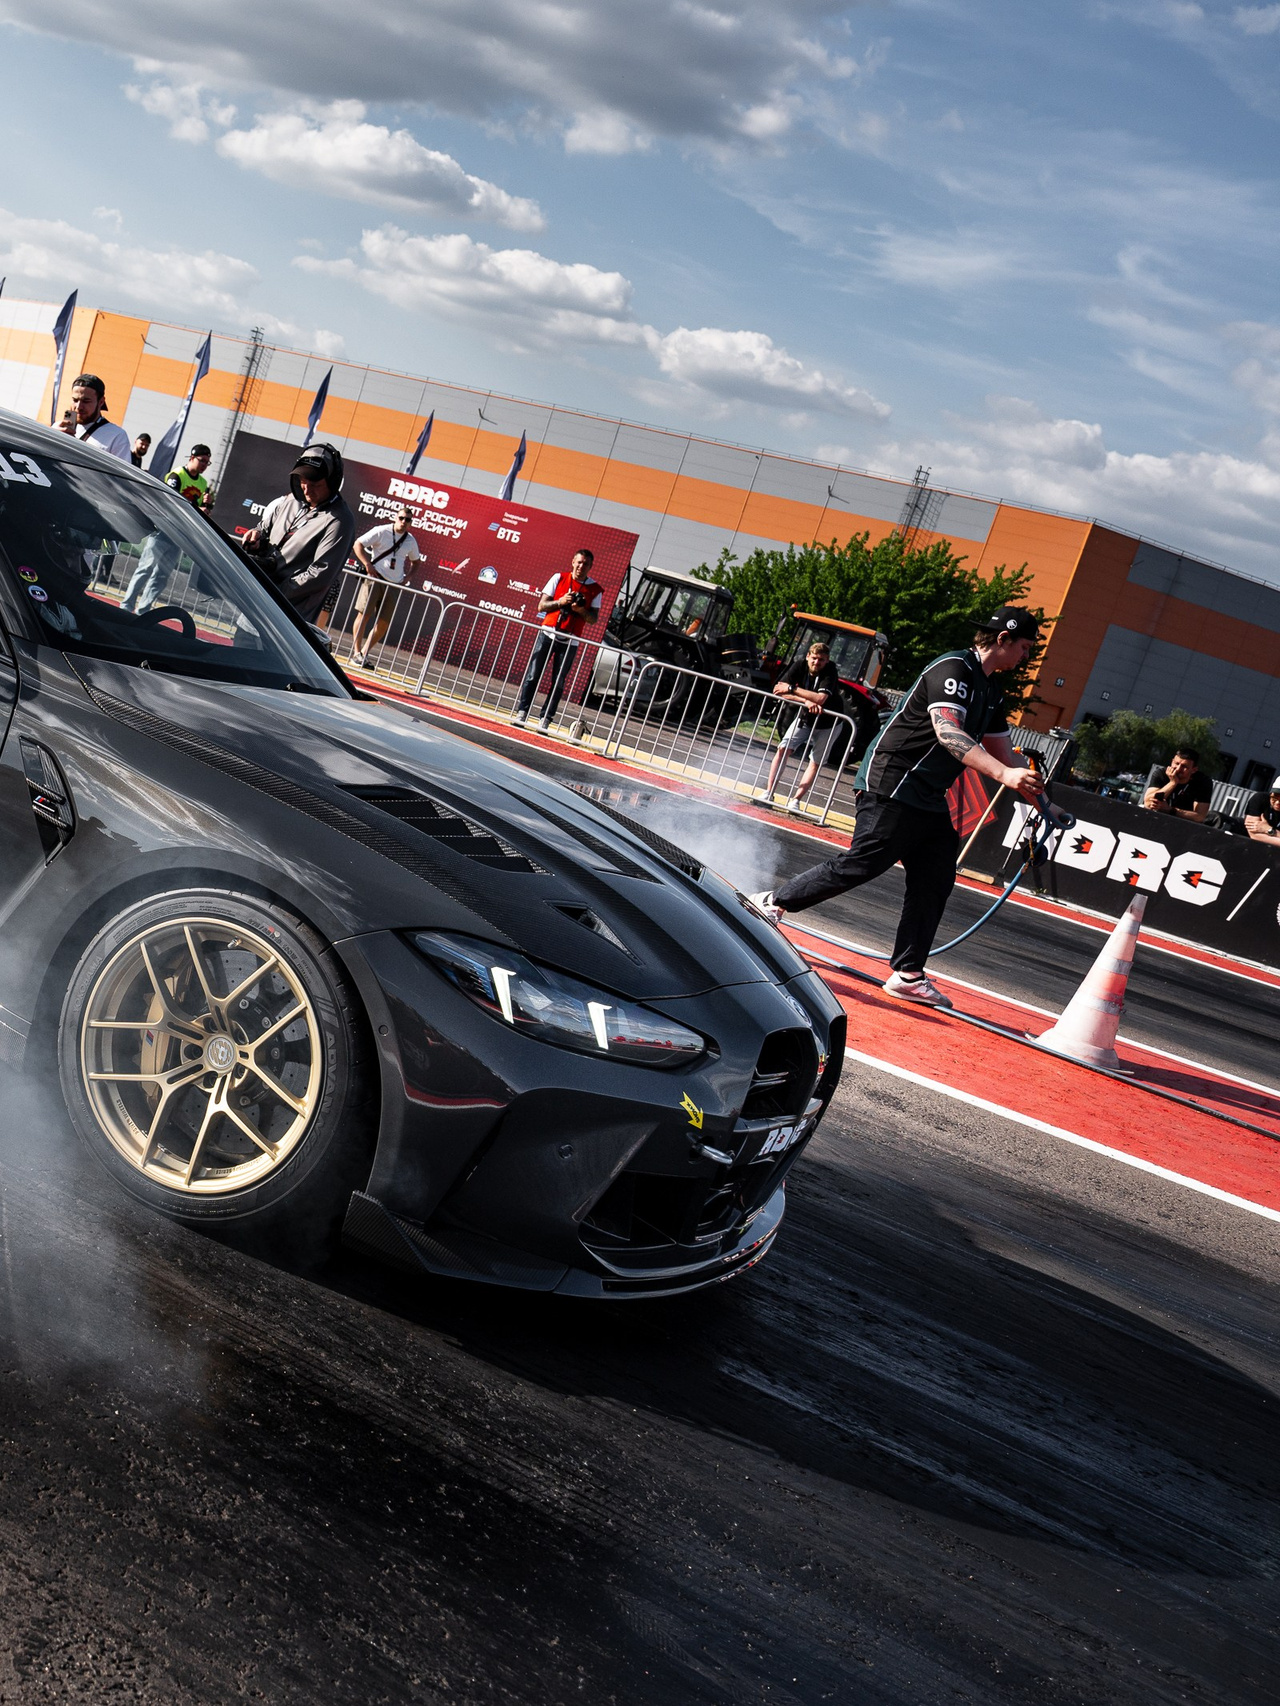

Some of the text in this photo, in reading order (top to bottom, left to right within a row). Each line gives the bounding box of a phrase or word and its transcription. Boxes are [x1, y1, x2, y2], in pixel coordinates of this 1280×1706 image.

[387, 477, 450, 510] RDRC
[250, 502, 266, 517] ВТ
[358, 502, 374, 515] ПО
[423, 509, 468, 530] РОССИИ
[496, 526, 521, 543] ВТБ
[431, 584, 468, 601] ЧЕМПИОНАТ
[478, 600, 524, 618] ROSGONKI
[943, 678, 968, 699] 95
[1002, 801, 1227, 906] RDRC
[72, 955, 104, 1013] YOKOHAMA
[322, 1030, 338, 1114] ADVAN
